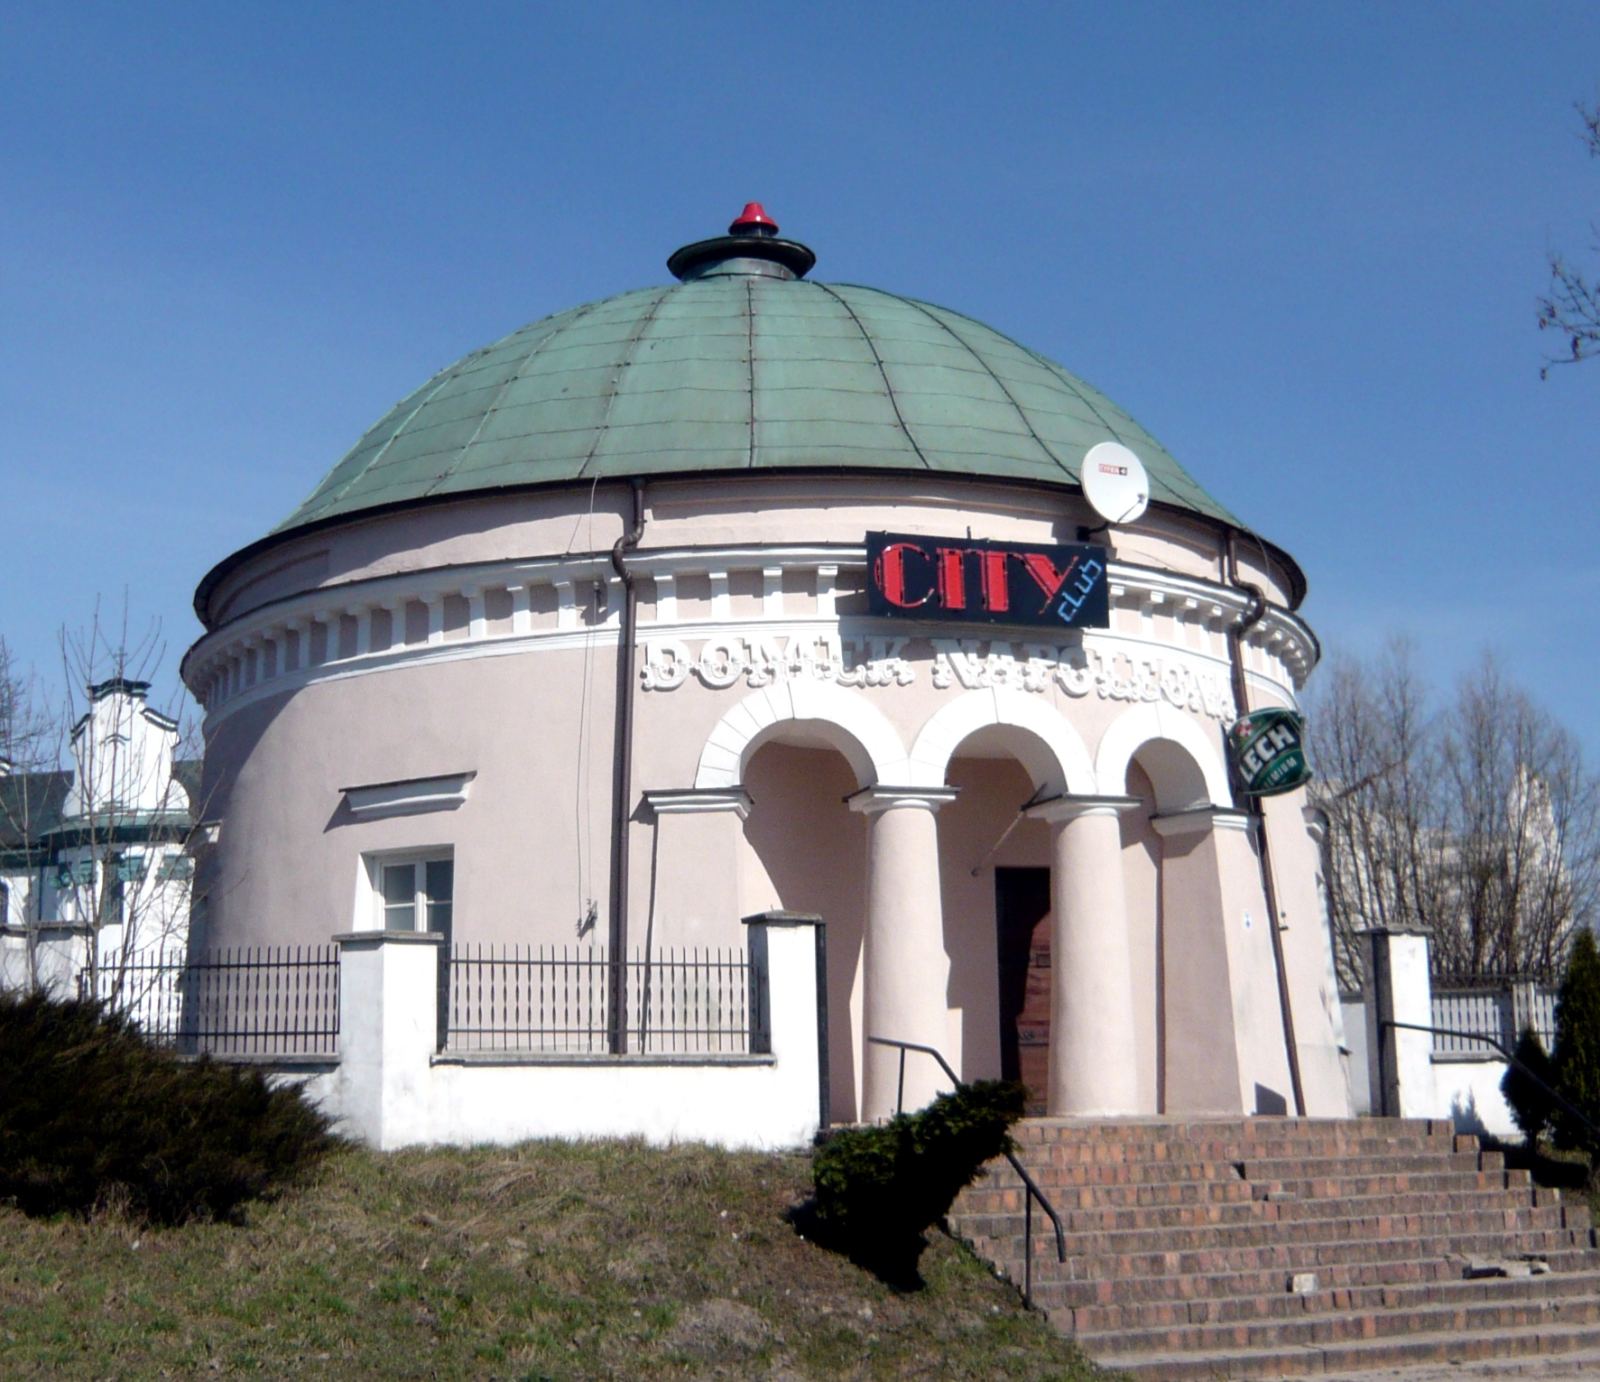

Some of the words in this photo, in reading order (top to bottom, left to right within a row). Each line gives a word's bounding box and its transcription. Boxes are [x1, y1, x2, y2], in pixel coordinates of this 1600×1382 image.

[874, 542, 1080, 616] CITY
[641, 635, 916, 692] DOMEK
[931, 637, 1238, 723] NAPOLEONA
[1239, 723, 1296, 784] LECH
